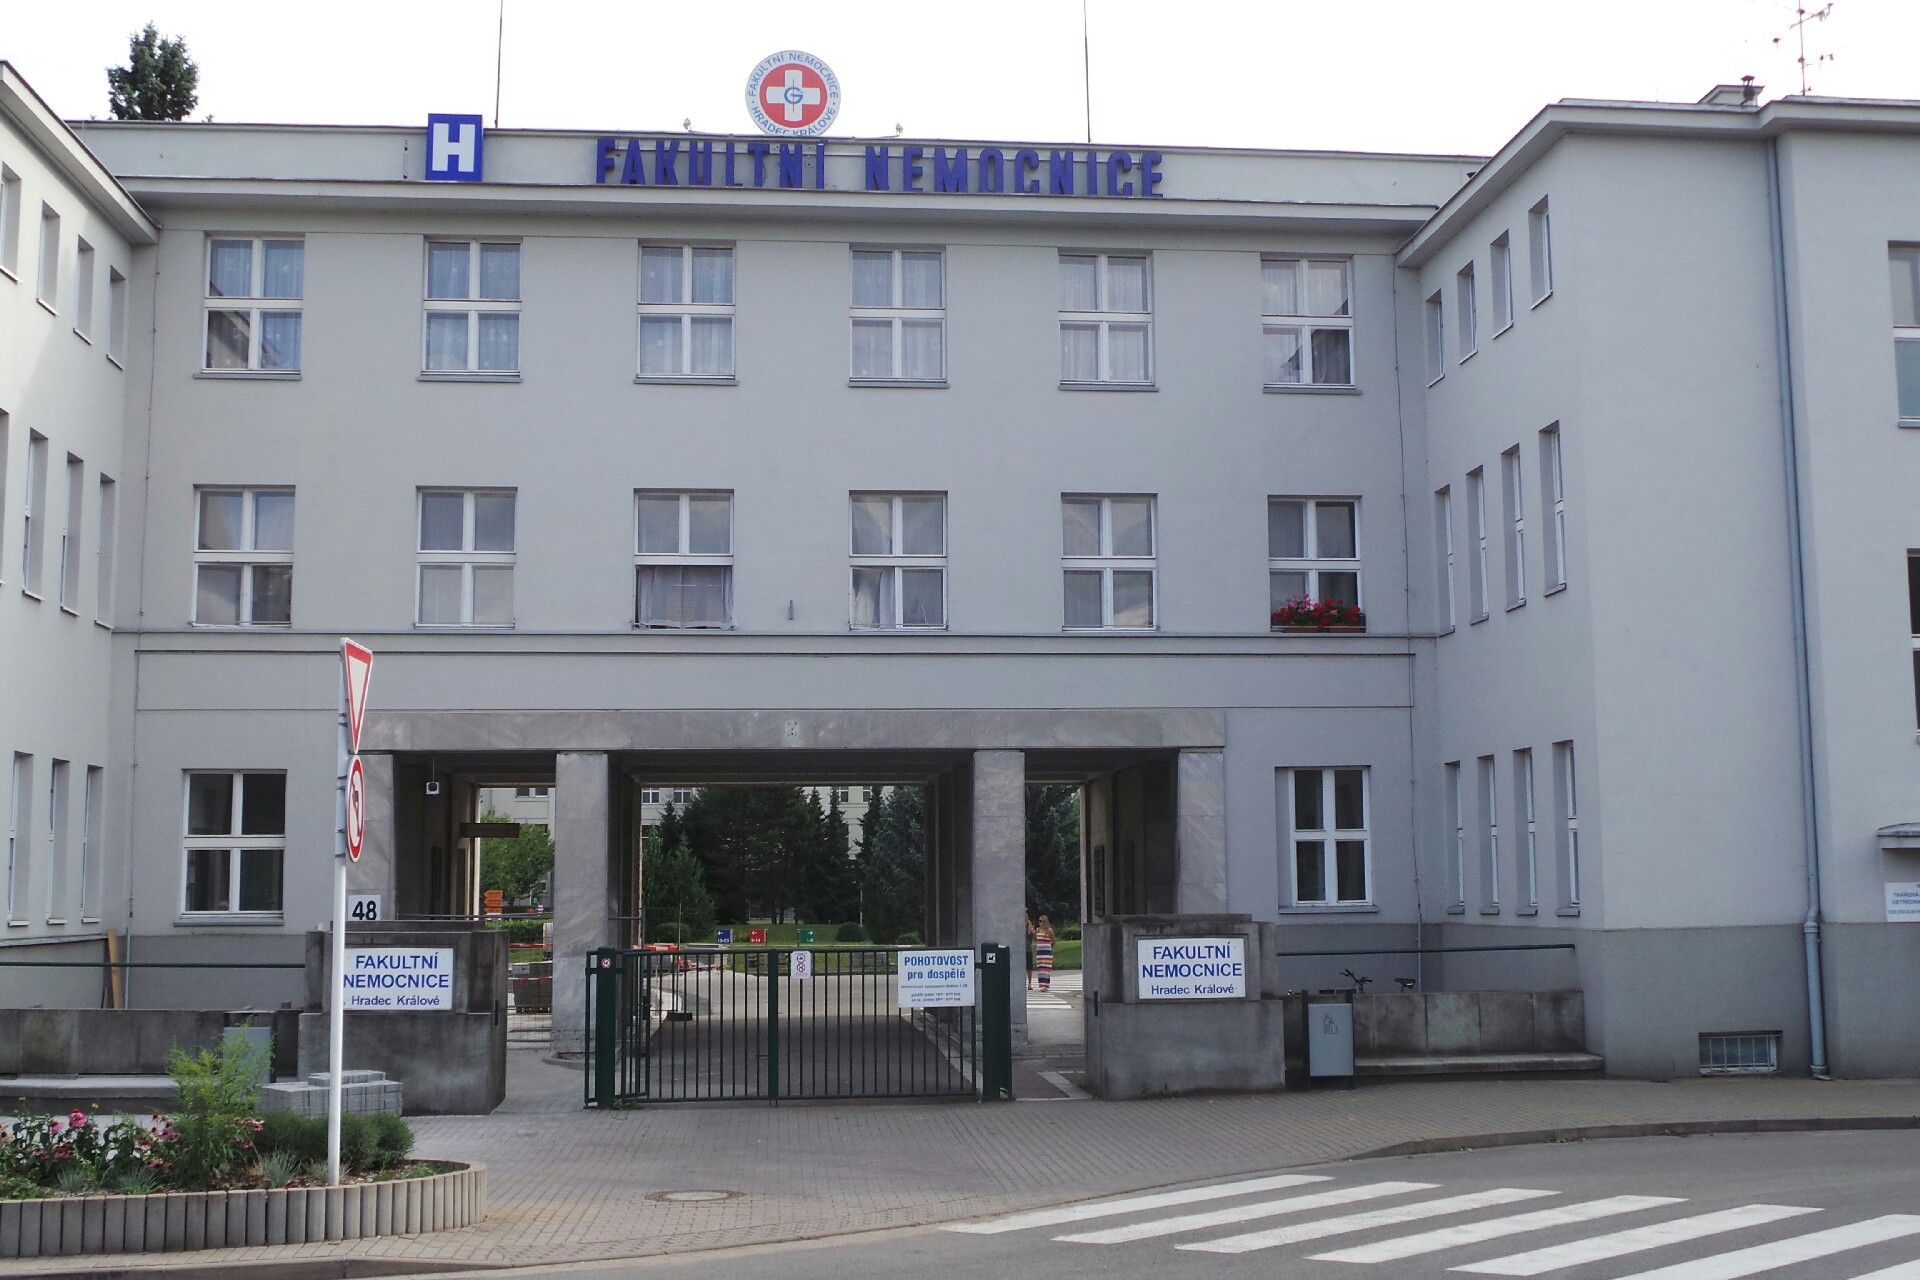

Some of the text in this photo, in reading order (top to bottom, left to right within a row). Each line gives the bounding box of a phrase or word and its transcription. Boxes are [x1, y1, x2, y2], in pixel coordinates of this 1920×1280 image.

[789, 52, 839, 99] NEMOCNICE
[432, 123, 475, 172] H
[596, 138, 1164, 198] FAKULTNÍ NEMOCNICE
[352, 900, 377, 920] 48
[1153, 942, 1231, 960] FAKULTNÍ
[355, 952, 439, 969] FAKULTNÍ
[904, 955, 969, 966] POHOTOVOST
[907, 968, 966, 981] pro dospělé
[1142, 963, 1243, 978] NEMOCNICE
[343, 974, 449, 988] NEMOCNICE
[1151, 983, 1235, 995] Hradec Králové
[351, 995, 440, 1005] Hradec Králové
